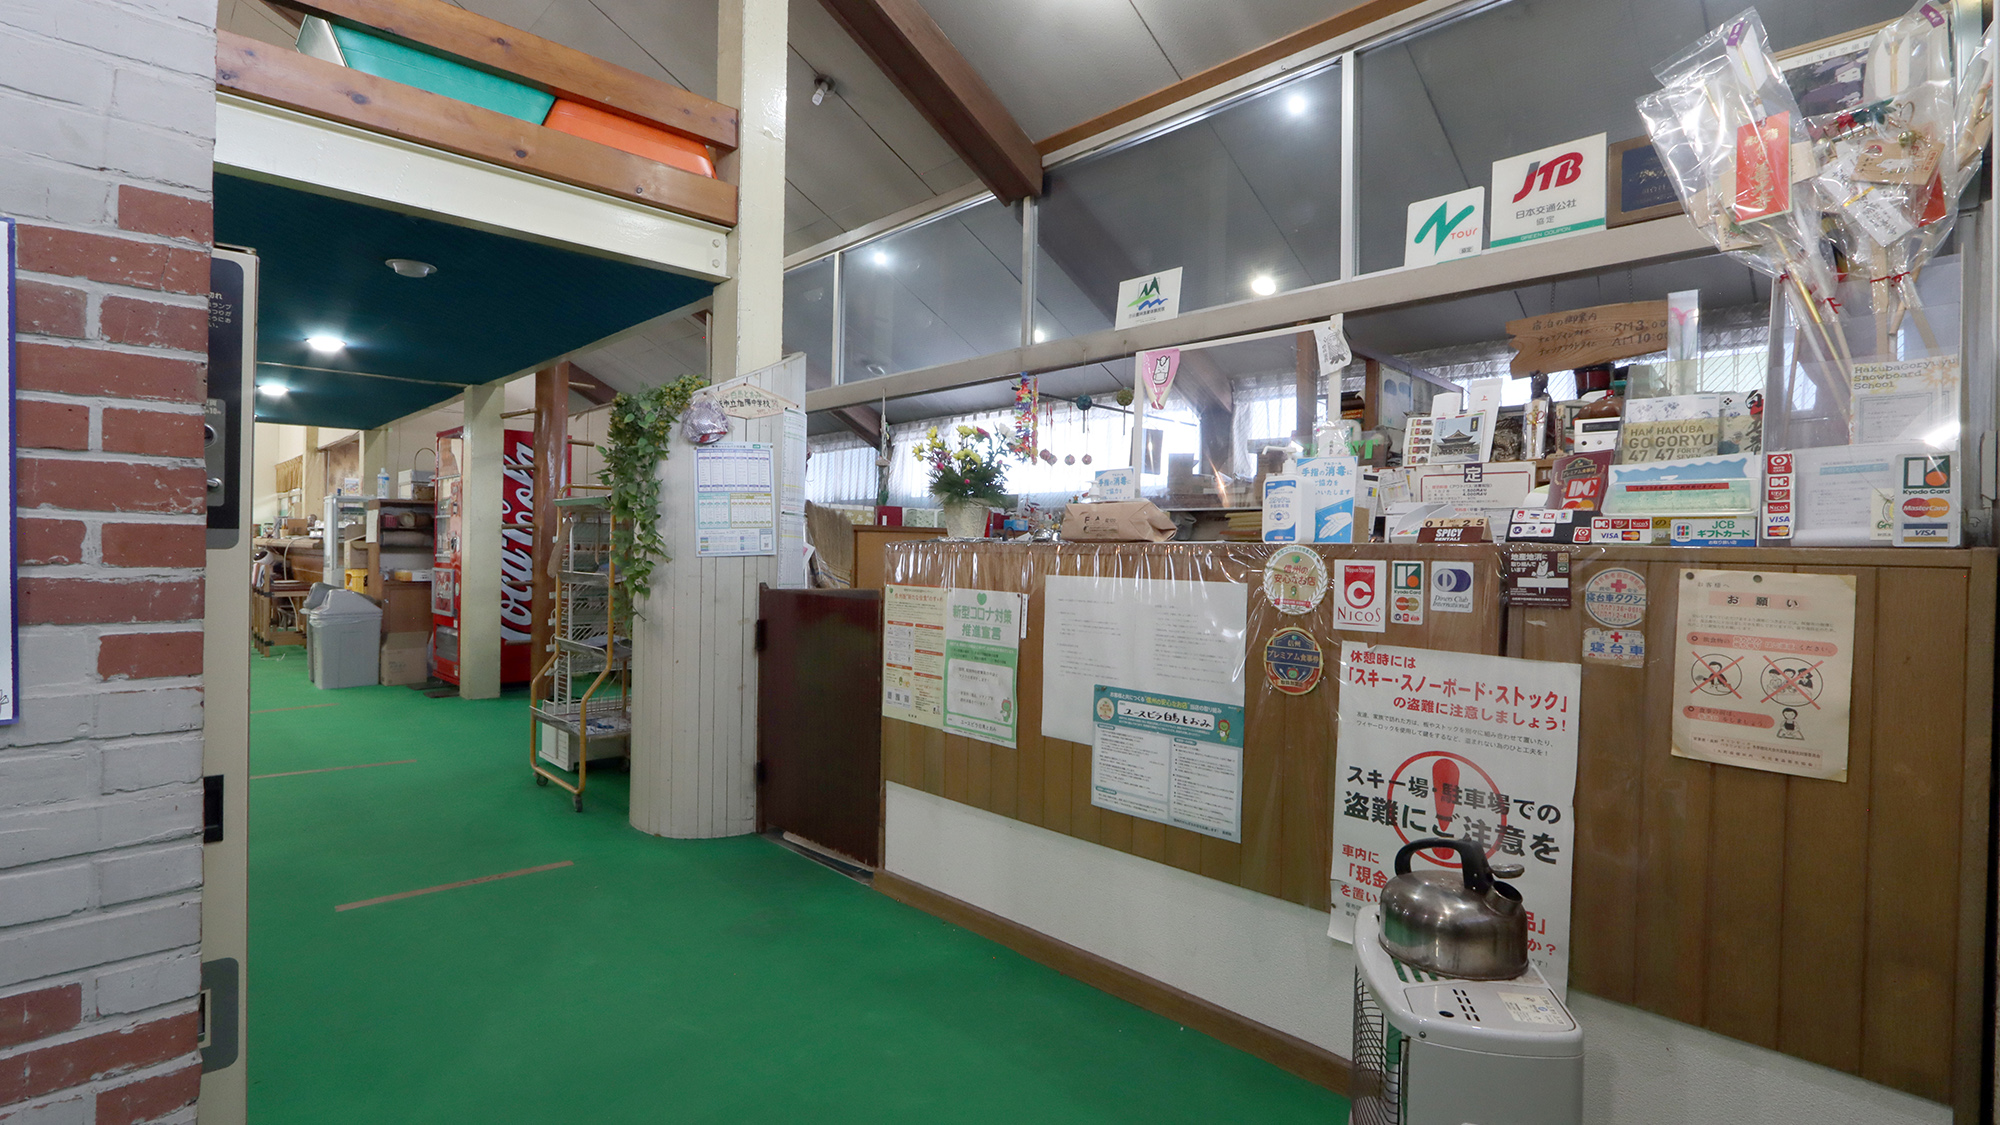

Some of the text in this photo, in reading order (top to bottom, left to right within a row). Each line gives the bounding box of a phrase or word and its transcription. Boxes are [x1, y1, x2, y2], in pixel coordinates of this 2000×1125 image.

[1512, 151, 1584, 204] JTB
[1515, 198, 1577, 220] 日本交通公社
[1614, 322, 1633, 332] PM
[1612, 336, 1632, 347] AM
[1854, 370, 1922, 382] Snowboard
[1854, 381, 1895, 390] School
[1656, 425, 1704, 435] HAKUBA
[1655, 433, 1714, 448] GORYU
[1628, 450, 1649, 462] 47
[1654, 448, 1676, 461] 47
[1301, 465, 1353, 477] 手指の消毒に
[1465, 466, 1482, 482] 定
[1771, 477, 1788, 487] DC
[1568, 479, 1598, 498] DC
[1594, 520, 1609, 528] DC
[1712, 520, 1735, 530] JCB
[1769, 515, 1790, 523] VISA
[1435, 528, 1464, 537] SPICY
[1697, 529, 1750, 538] ギフトカード
[1511, 553, 1548, 561] 地産地消に
[1284, 564, 1309, 575] 信州の
[1274, 574, 1316, 587] 安心なお店
[1434, 594, 1469, 603] Diners Club
[1726, 594, 1799, 609] お願い
[1432, 601, 1471, 609] International
[952, 604, 1012, 625] 新型コロナ対策
[961, 622, 1002, 641] 推進宣言
[1590, 641, 1644, 656] 寝台車
[1350, 650, 1417, 669] 休憩時には
[1348, 667, 1568, 713] 「スキー・スノーボード・ストック」
[1393, 696, 1567, 732] の盗難に注意しましょう！
[1347, 765, 1561, 824] スキー場・駐車場での
[1343, 790, 1561, 865] 盗難にご注意を
[1342, 844, 1380, 864] 車内に
